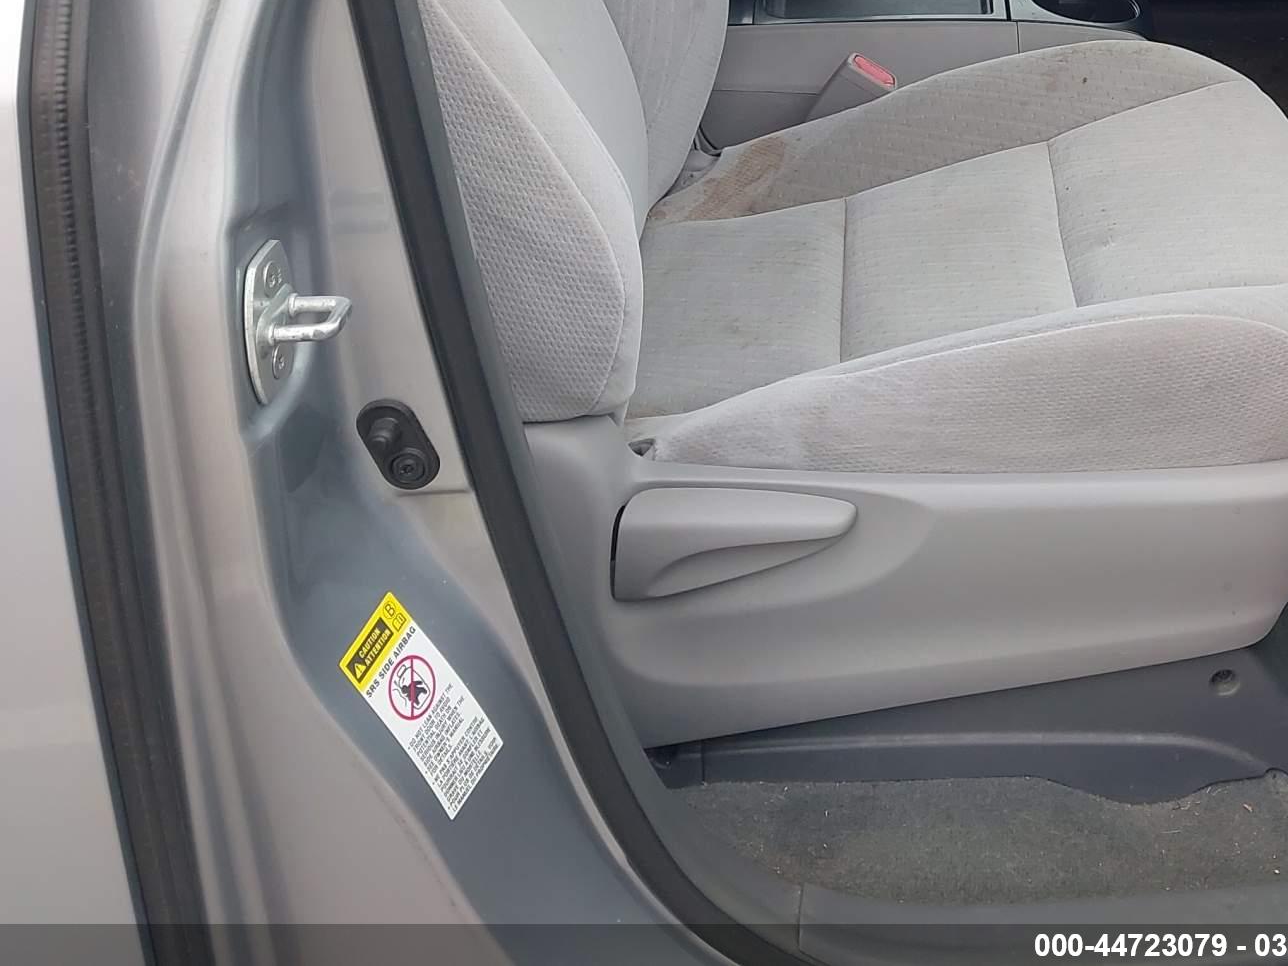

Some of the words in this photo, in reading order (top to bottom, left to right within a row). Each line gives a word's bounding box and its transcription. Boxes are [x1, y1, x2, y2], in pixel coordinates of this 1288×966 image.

[384, 601, 395, 617] B
[358, 626, 380, 659] CAUTION
[363, 627, 390, 666] ATTENTION
[365, 677, 380, 698] SRS
[378, 656, 394, 680] SIDE
[392, 624, 415, 658] AIRBAG
